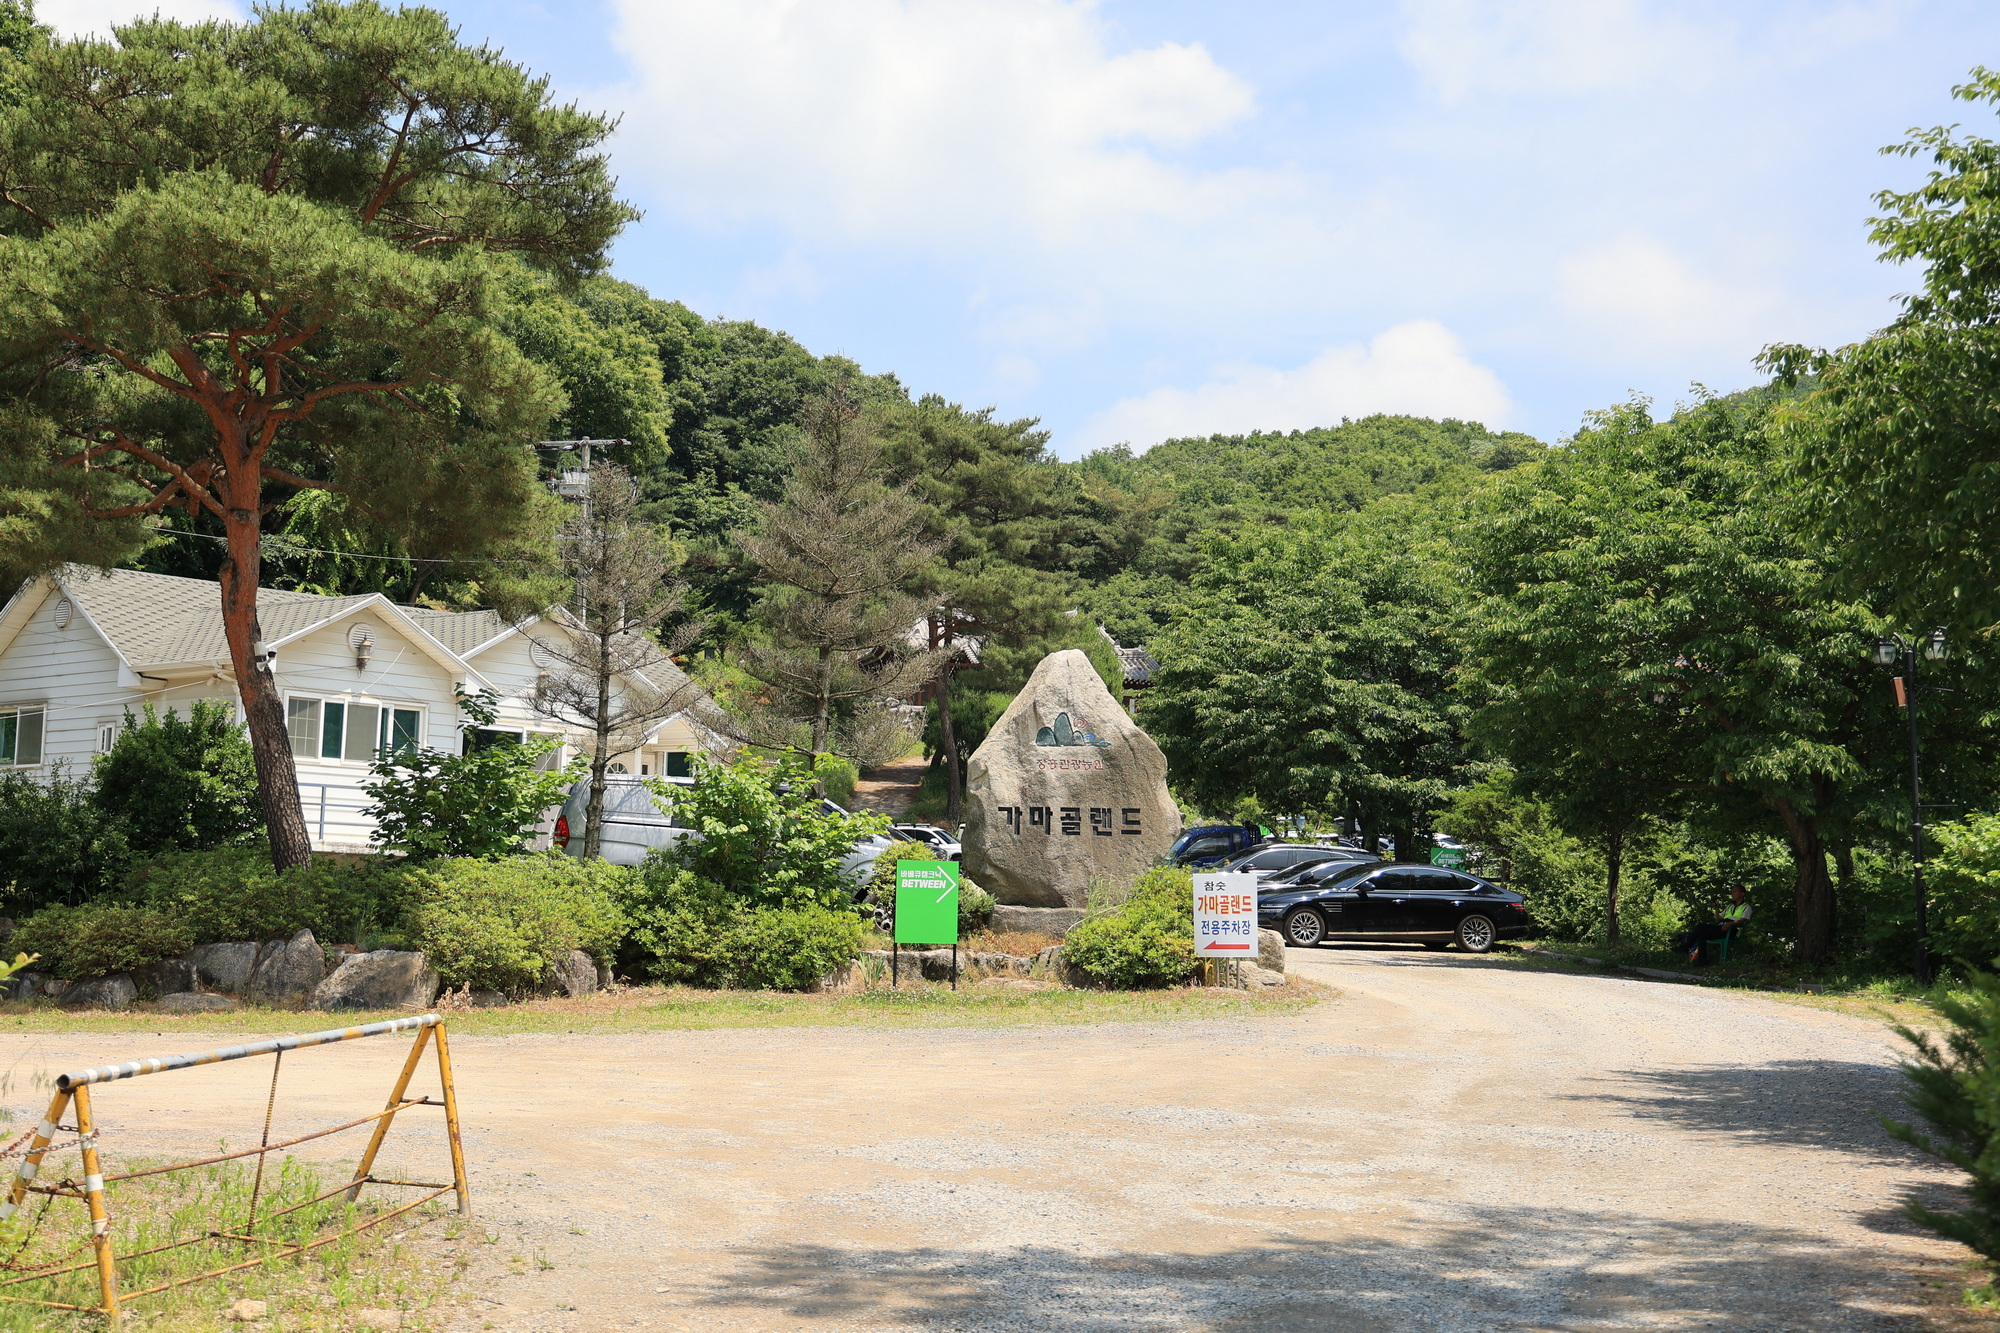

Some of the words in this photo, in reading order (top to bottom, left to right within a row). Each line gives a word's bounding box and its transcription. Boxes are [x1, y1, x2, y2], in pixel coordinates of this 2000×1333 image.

[998, 806, 1142, 836] 가마골랜드
[901, 879, 946, 888] BETWEEN
[1198, 895, 1252, 915] 가마골랜드
[1201, 920, 1251, 935] 전용주차장
